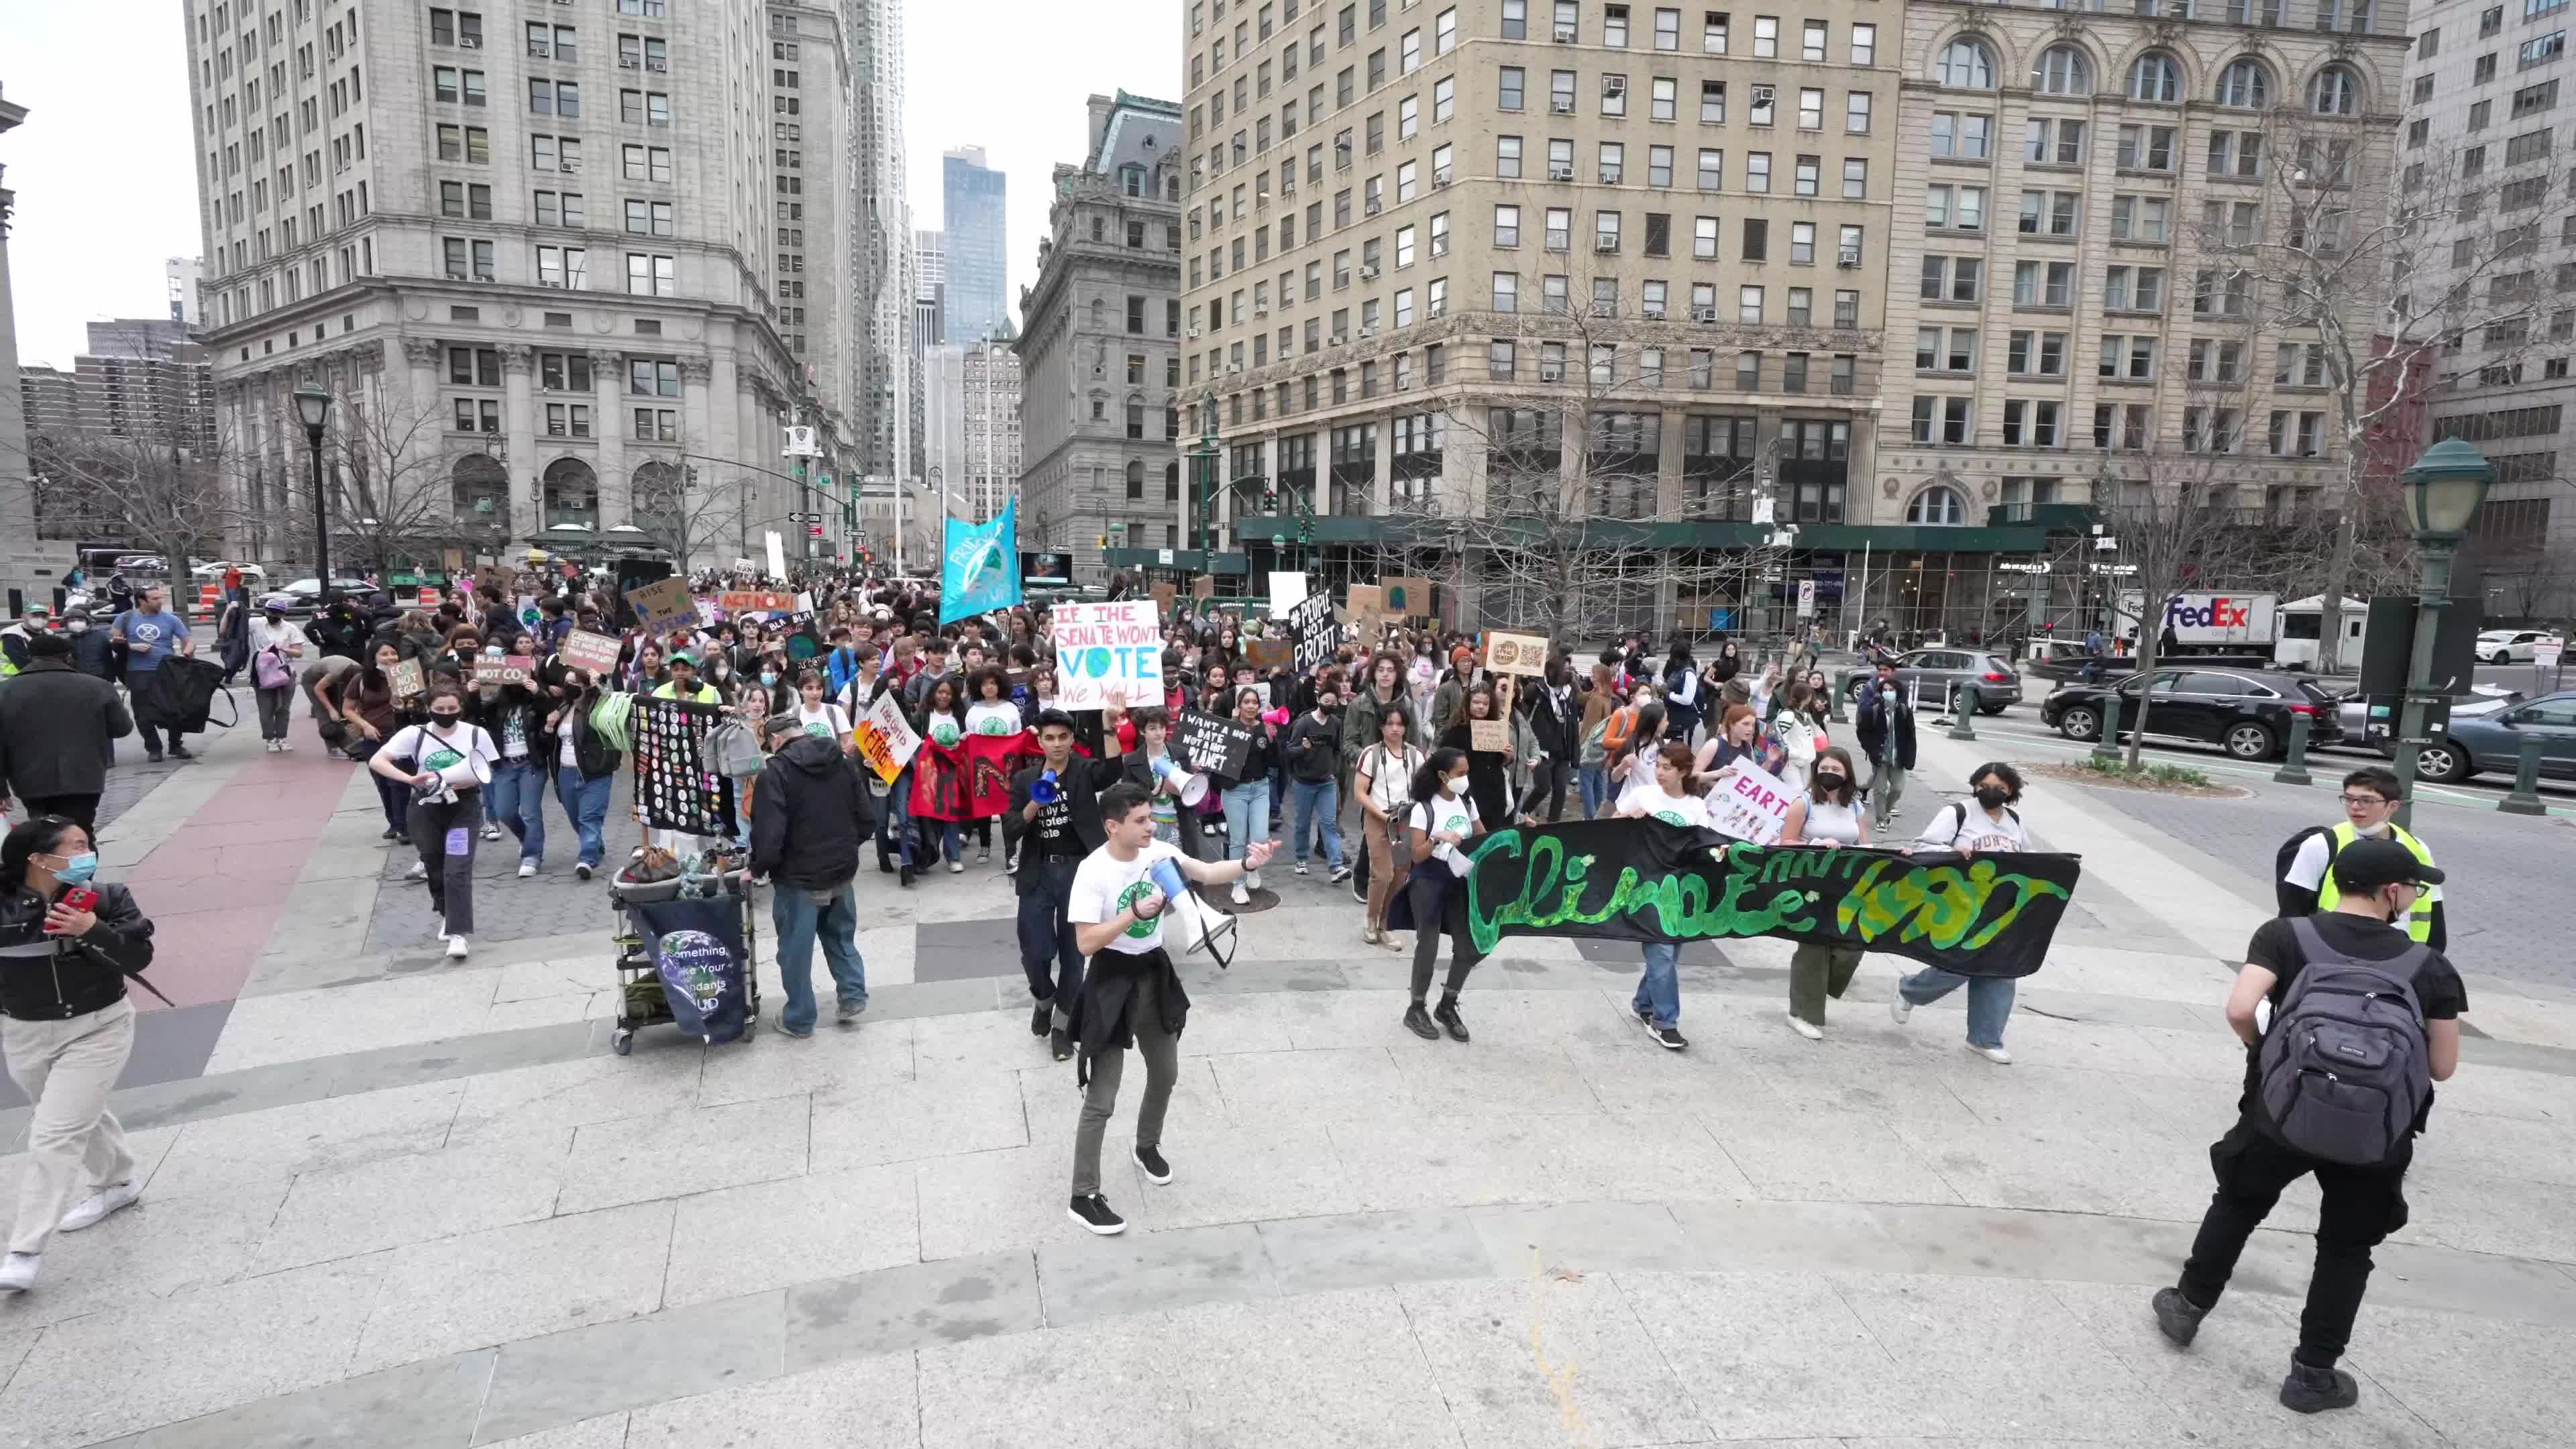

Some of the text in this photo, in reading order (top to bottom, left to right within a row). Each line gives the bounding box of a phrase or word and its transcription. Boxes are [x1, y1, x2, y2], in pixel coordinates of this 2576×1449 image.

[639, 585, 664, 600] RISE
[723, 593, 752, 607] ACT
[1055, 605, 1136, 623] IF THE
[2127, 602, 2145, 612] Fed
[2167, 597, 2247, 627] FedEx
[769, 611, 811, 631] BLA BLA
[1303, 617, 1324, 641] NOT
[1056, 625, 1159, 647] SENATE WONT
[1294, 625, 1335, 672] PROFIT
[1059, 647, 1159, 679] VOTE
[397, 672, 417, 686] NOT
[476, 669, 499, 679] NOT
[398, 682, 419, 697] EGO
[1179, 712, 1184, 722] I
[1187, 714, 1219, 730] WANT
[1222, 726, 1228, 735] A
[1183, 734, 1203, 747] NOT
[1202, 741, 1209, 749] A
[1197, 729, 1224, 743] DATE
[1189, 747, 1227, 771] PLANET
[1734, 775, 1790, 816] EART
[1061, 804, 1069, 812] &
[700, 963, 725, 974] Your
